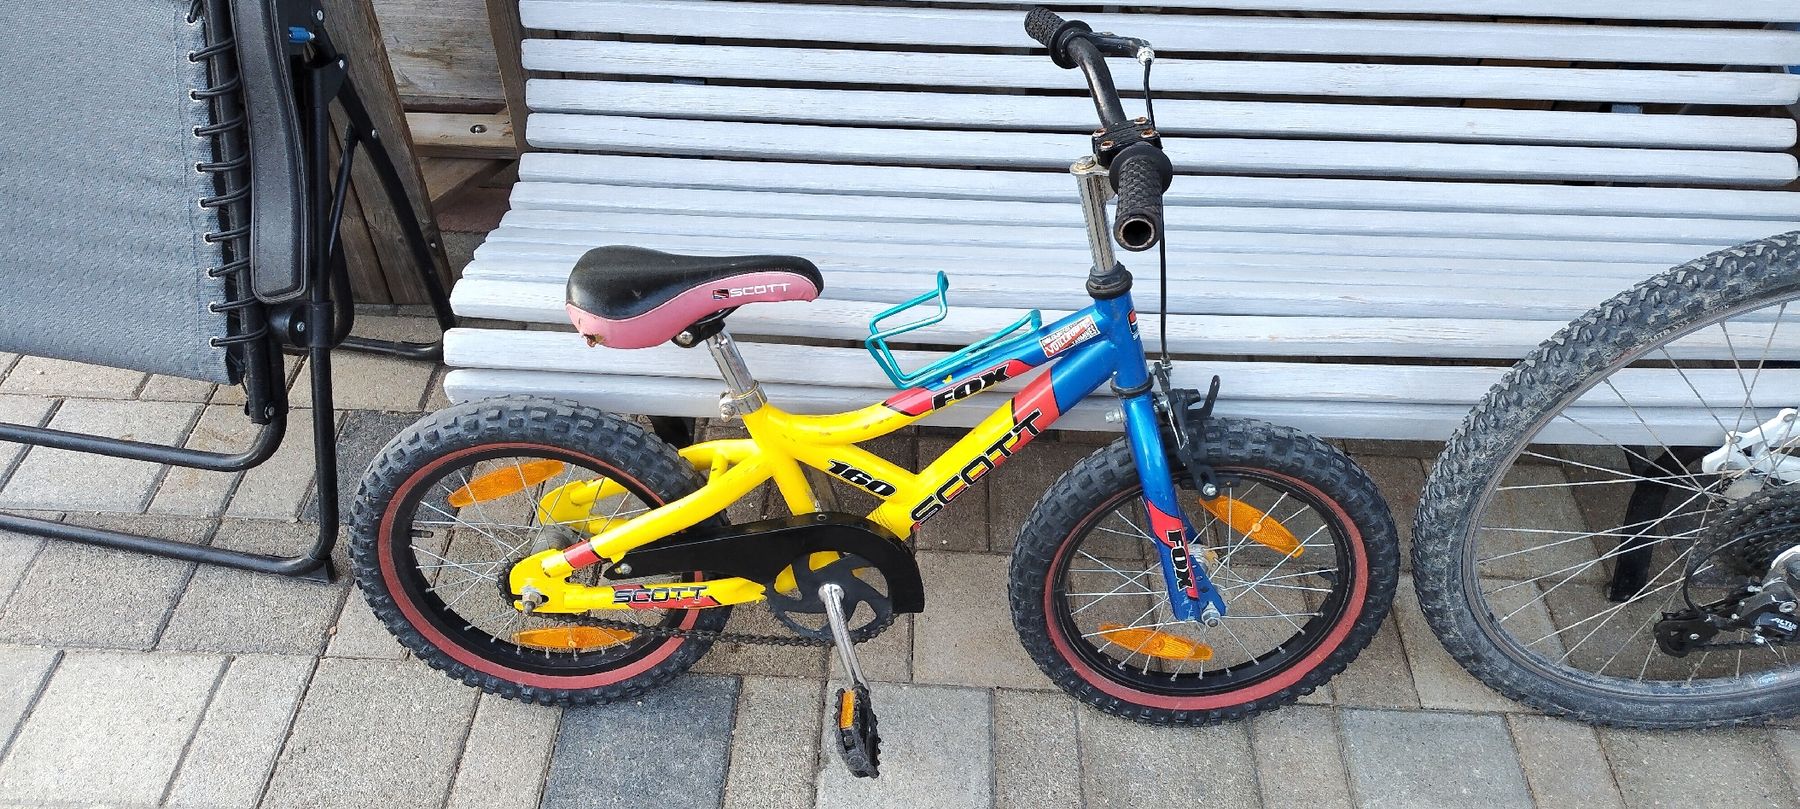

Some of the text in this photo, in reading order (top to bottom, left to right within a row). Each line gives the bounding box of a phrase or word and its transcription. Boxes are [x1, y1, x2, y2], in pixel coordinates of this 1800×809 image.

[731, 283, 791, 297] SCOTT
[932, 364, 1010, 411] FOX
[826, 459, 897, 497] 160
[910, 408, 1043, 522] SCOTT
[1166, 529, 1194, 591] FOX
[613, 586, 707, 604] SCOTT
